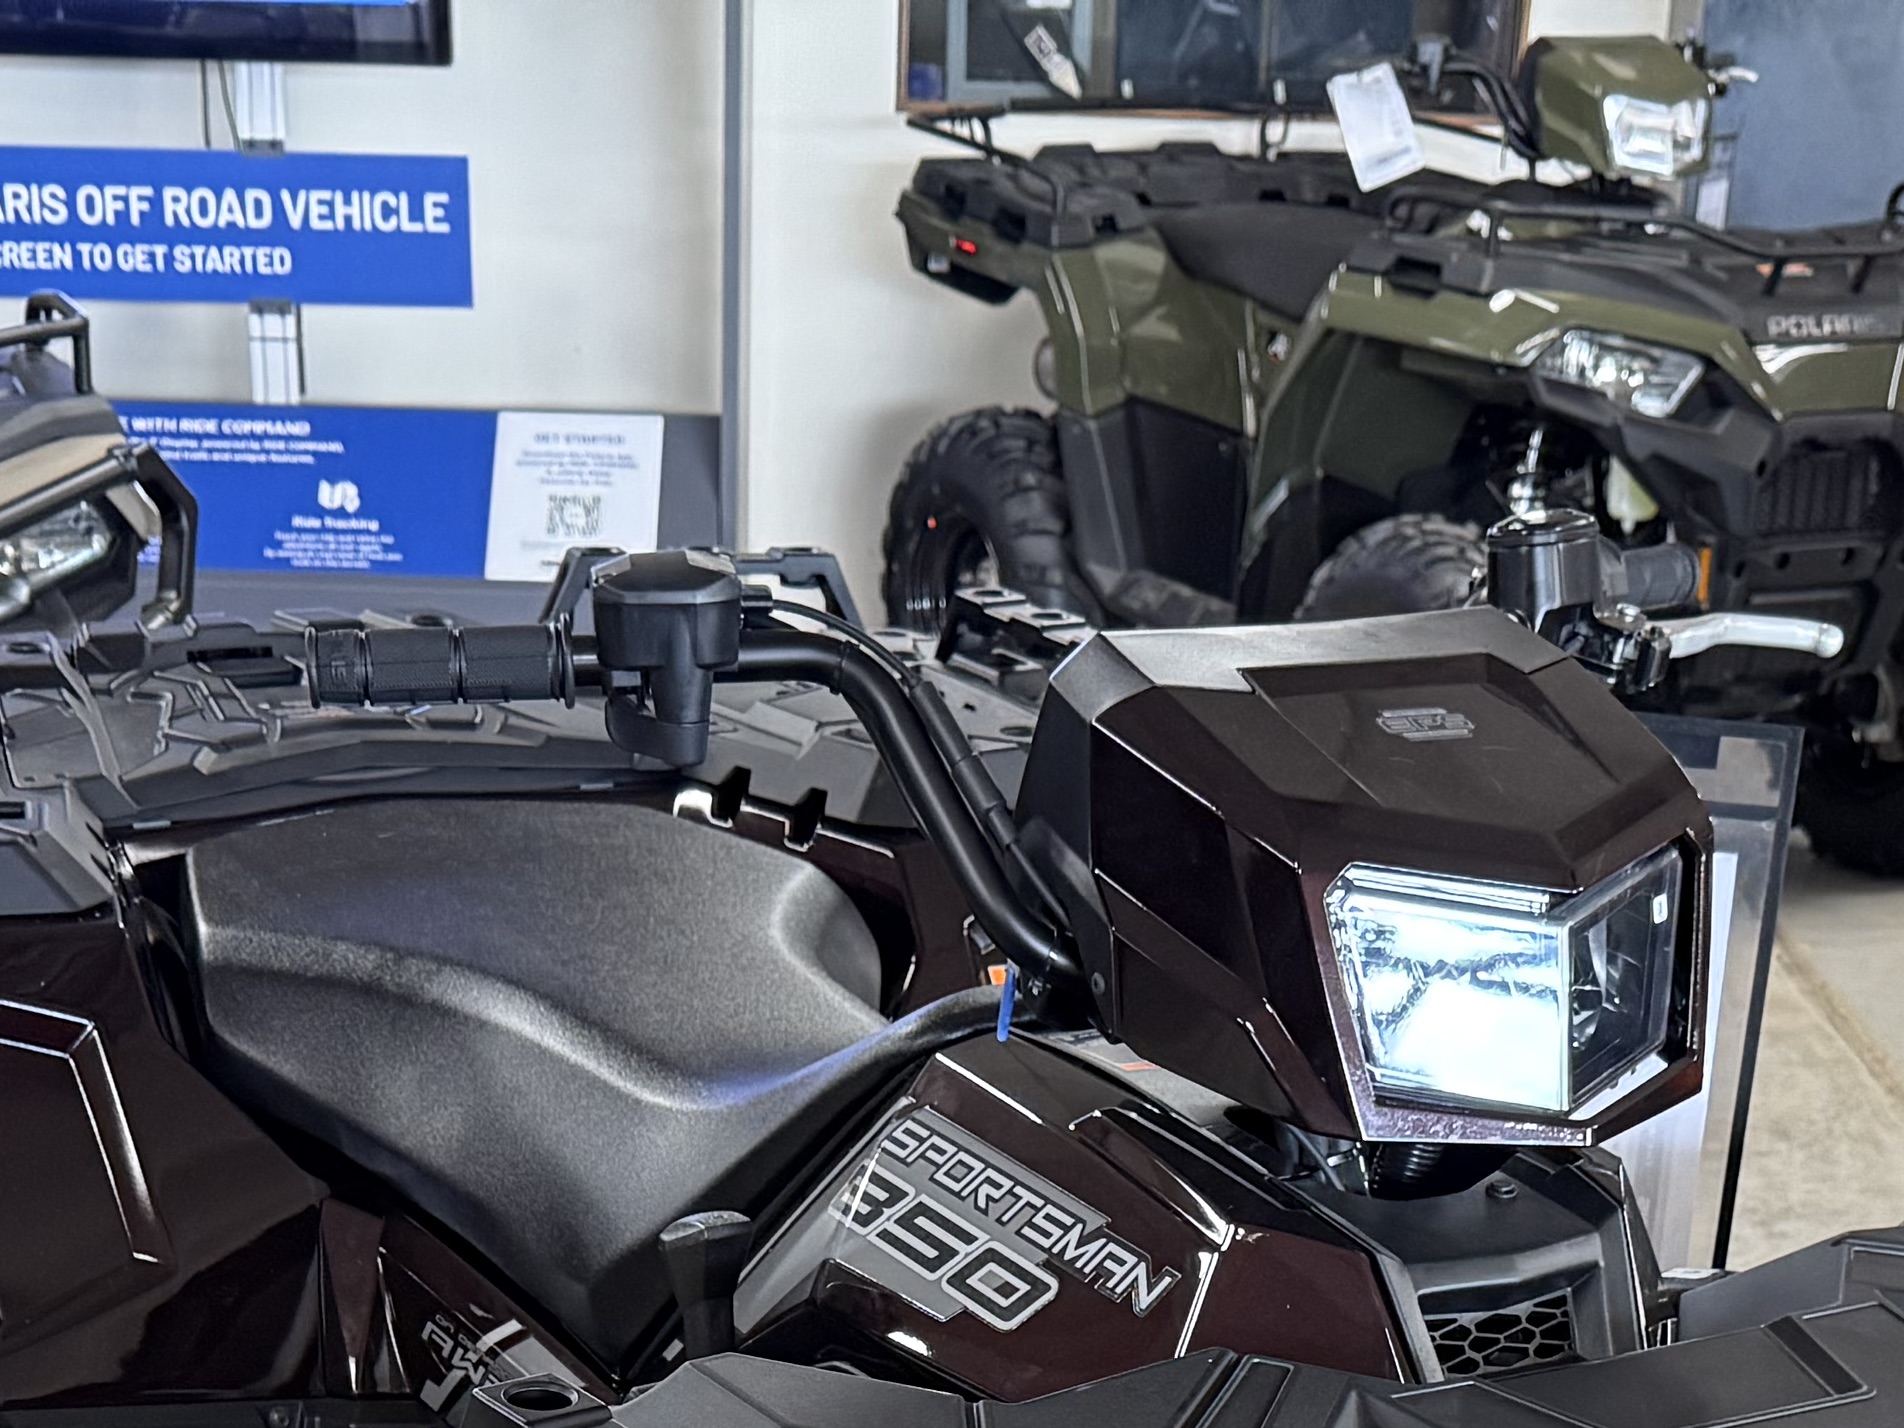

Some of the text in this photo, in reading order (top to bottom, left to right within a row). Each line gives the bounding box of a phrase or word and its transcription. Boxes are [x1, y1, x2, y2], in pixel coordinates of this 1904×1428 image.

[76, 184, 153, 227] OFF
[162, 186, 273, 229] ROAD
[280, 188, 450, 233] VEHICLE
[76, 242, 112, 271] TO
[116, 243, 168, 272] GET
[173, 244, 293, 275] STARTED
[882, 1119, 1178, 1315] SPORTSMAN
